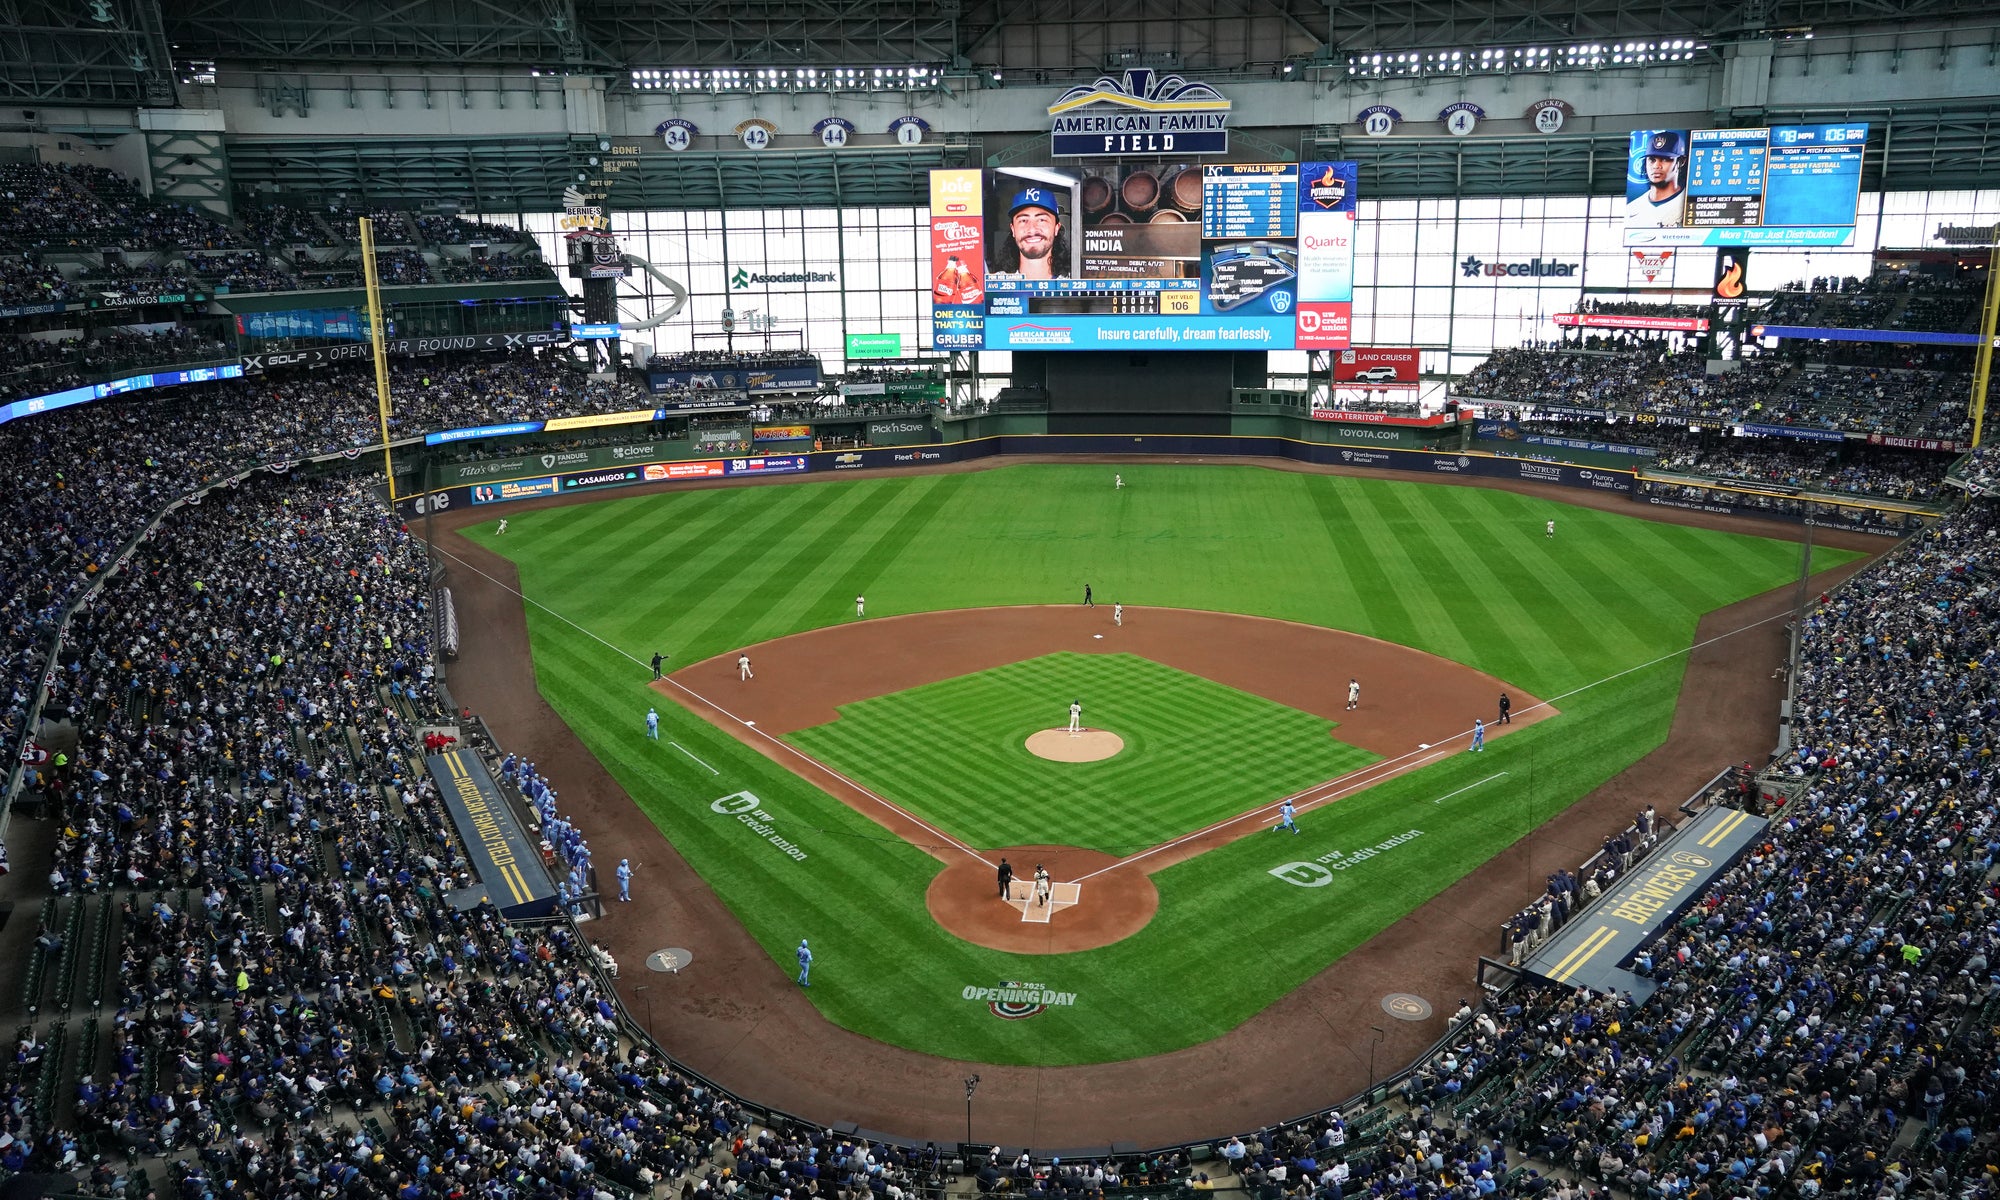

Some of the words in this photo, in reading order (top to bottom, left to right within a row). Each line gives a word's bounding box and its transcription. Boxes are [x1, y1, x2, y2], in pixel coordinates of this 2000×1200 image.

[1445, 104, 1479, 114] MOLITOR
[1534, 100, 1565, 110] UECKER
[1367, 107, 1393, 115] YOUNT
[1540, 110, 1558, 122] 50
[661, 121, 693, 130] FINGERS
[823, 118, 846, 127] AARON
[899, 116, 920, 125] SELIG
[1054, 116, 1150, 132] AMERICAN
[1159, 114, 1227, 130] FAMILY
[1369, 118, 1389, 133] 19
[1455, 116, 1466, 130] 4
[667, 130, 688, 145] 34
[746, 129, 766, 144] 42
[825, 129, 844, 144] 44
[906, 128, 914, 142] 1
[1693, 132, 1717, 140] ELVIN
[1719, 131, 1768, 140] RODRIGUEZ
[1780, 130, 1797, 143] 78
[1798, 132, 1815, 140] MPH
[1825, 128, 1846, 142] 106
[1104, 135, 1174, 152] FIELD
[612, 146, 641, 155] GONE!
[1234, 165, 1261, 173] ROYALS
[1769, 162, 1808, 170] FOUR-SEAM
[1025, 188, 1040, 201] KC
[1310, 187, 1346, 197] POTAWATOMI
[567, 207, 601, 216] BERNIE'S
[560, 215, 610, 231] CHALET
[945, 225, 980, 240] Coke
[1085, 230, 1124, 238] JONATHAN
[1720, 230, 1743, 240] More
[1743, 230, 1765, 239] Than
[1766, 230, 1785, 239] Just
[1785, 229, 1838, 239] Distribution!
[1085, 239, 1123, 252] INDIA
[1304, 236, 1347, 250] Quartz
[1483, 258, 1579, 278] uscellular
[1638, 258, 1667, 267] VIZZY
[104, 296, 158, 307] CASAMIGOS
[1170, 301, 1189, 311] 106
[23, 306, 42, 315] LEGENDS
[42, 304, 55, 313] CLUB
[935, 311, 954, 319] ONE
[1554, 315, 1574, 323] VIZZY
[935, 321, 965, 329] THAT'S
[965, 321, 984, 329] ALL!
[526, 333, 566, 344] GOLF
[936, 334, 983, 344] GRUBER
[1097, 328, 1131, 340] Insure
[1133, 327, 1180, 342] carefully,
[1183, 327, 1216, 340] dream
[1218, 326, 1272, 343] fearlessly.
[329, 345, 367, 361] OPEN
[419, 336, 476, 350] ROUND
[268, 352, 308, 366] GOLF
[1357, 353, 1379, 362] LAND
[1380, 353, 1412, 362] CRUISER
[190, 370, 208, 381] 106
[746, 374, 776, 387] Miller
[778, 380, 812, 388] MILWAUKEE
[28, 398, 45, 411] one
[1314, 411, 1343, 420] TOYOTA
[1344, 412, 1385, 422] TERRITORY
[1636, 414, 1655, 423] 620
[1656, 415, 1687, 426] WTMJ
[900, 423, 923, 431] Save
[440, 430, 476, 441] WINTRUST
[700, 430, 741, 443] Johnsonville
[1339, 428, 1400, 441] TOYOTA.COM
[1783, 430, 1824, 438] WISCONSIN'S
[1543, 437, 1562, 446] WELCOME
[1609, 445, 1629, 453] WELCOME
[1885, 437, 1918, 448] NICOLET
[1920, 439, 1938, 450] LAW
[624, 446, 654, 456] clover
[1353, 451, 1389, 460] Northwestern
[732, 460, 747, 470] $20
[1434, 459, 1456, 468] Johnson
[1437, 464, 1459, 472] Controls
[1520, 462, 1561, 475] WINTRUST
[460, 465, 487, 477] Tito's
[578, 473, 625, 485] CASAMIGOS
[1593, 473, 1614, 482] Aurora
[1592, 480, 1613, 489] Health
[1613, 482, 1629, 490] Care
[1704, 505, 1731, 514] BULLPEN
[1867, 527, 1898, 537] BULLPEN
[453, 776, 486, 816] AMERICAN
[752, 809, 775, 822] uw
[471, 812, 504, 842] FAMILY
[737, 814, 775, 837] credit
[769, 835, 808, 862] union
[486, 839, 516, 867] FIELD
[1332, 847, 1380, 870] credit
[1376, 829, 1425, 851] union
[1316, 850, 1344, 864] uw
[1611, 864, 1698, 924] BREWERS
[1023, 982, 1046, 990] 2025
[962, 985, 1040, 1003] OPENING
[1042, 990, 1077, 1006] DAY
[1334, 1133, 1343, 1142] 22
